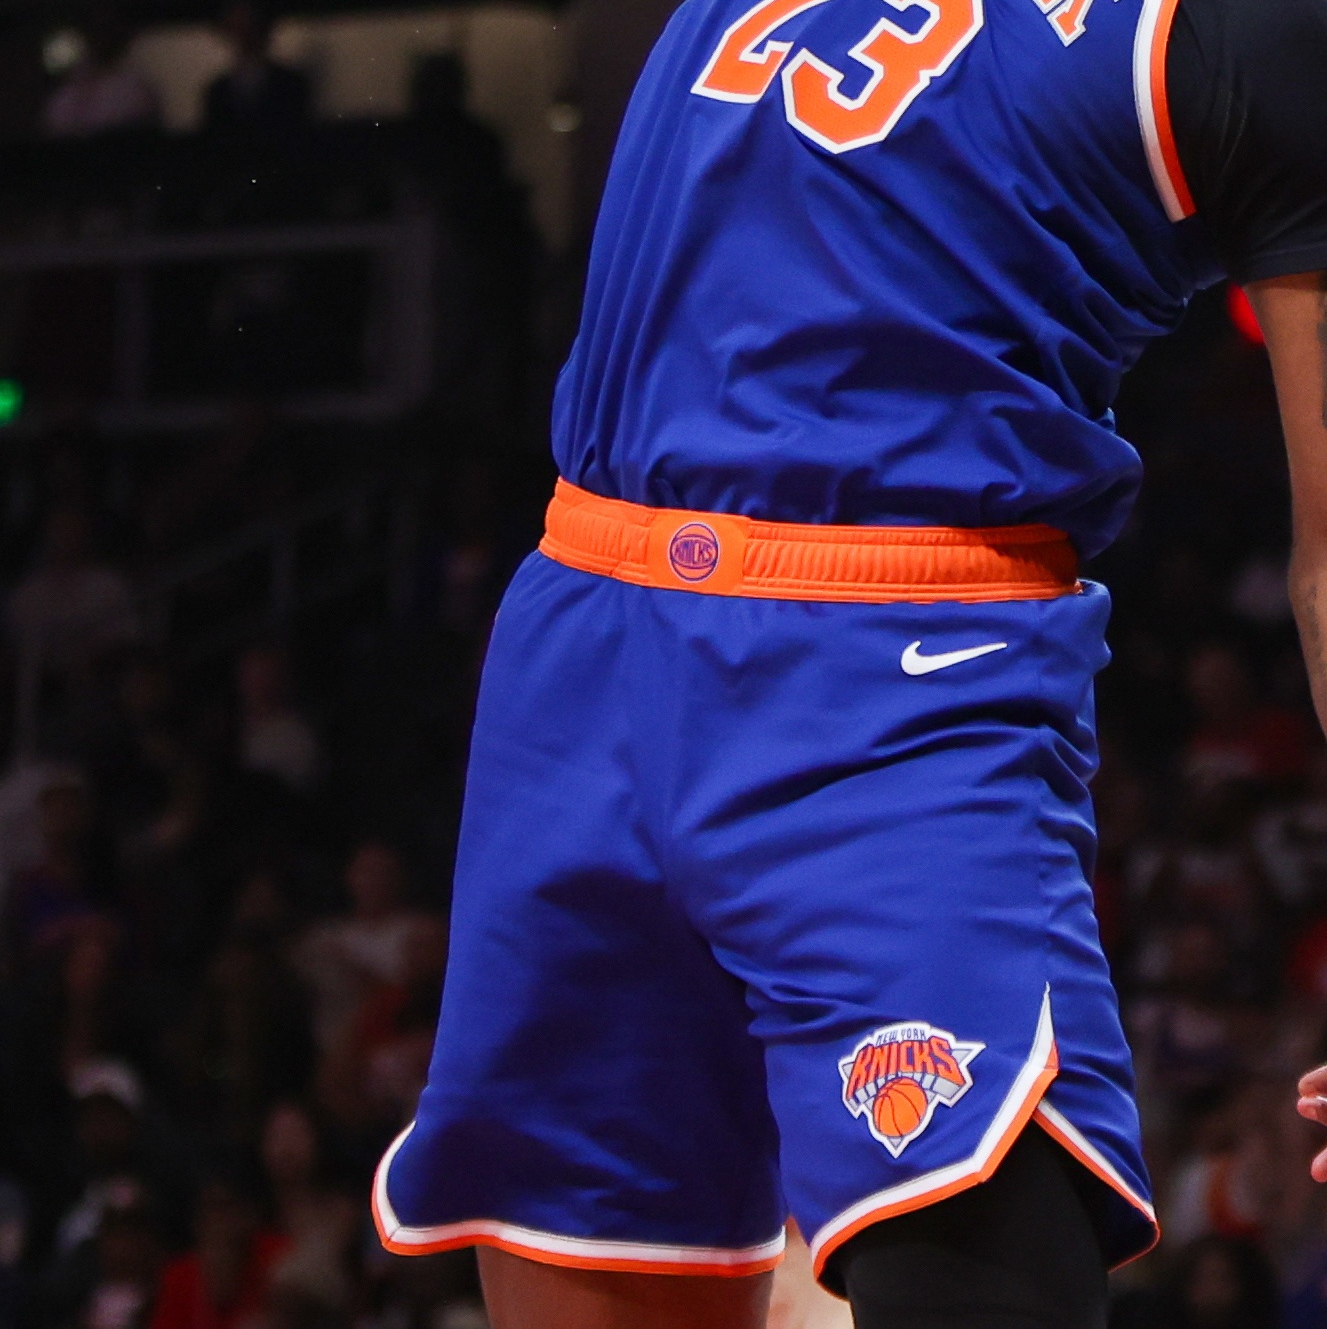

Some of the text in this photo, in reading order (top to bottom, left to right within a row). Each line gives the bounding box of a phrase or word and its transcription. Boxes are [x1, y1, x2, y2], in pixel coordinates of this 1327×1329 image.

[876, 1027, 927, 1045] NEW YORK
[845, 1035, 966, 1101] KNICKS
